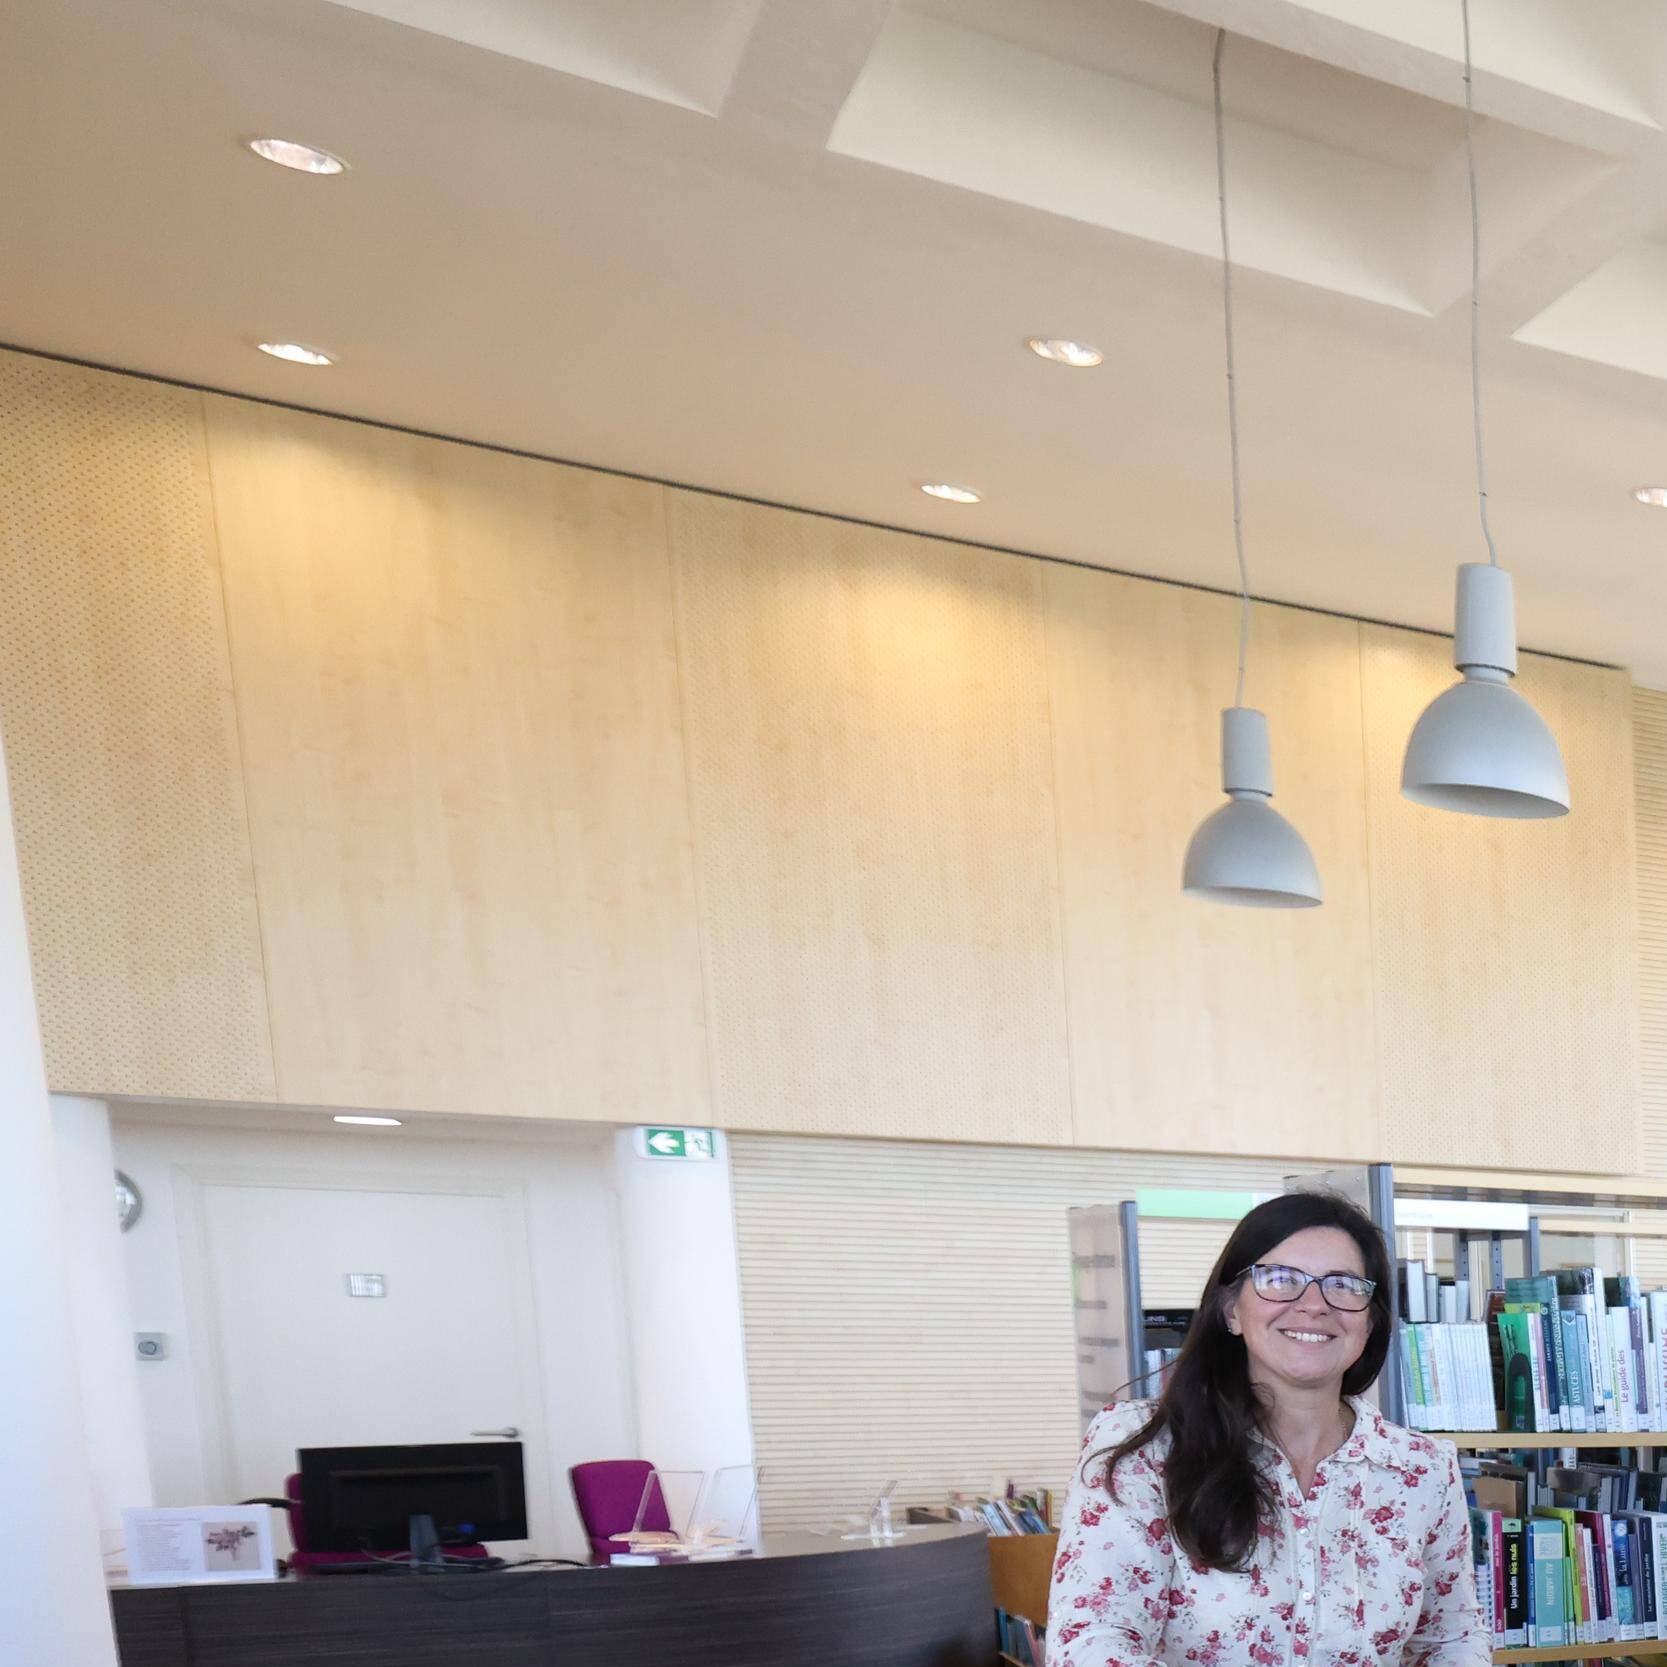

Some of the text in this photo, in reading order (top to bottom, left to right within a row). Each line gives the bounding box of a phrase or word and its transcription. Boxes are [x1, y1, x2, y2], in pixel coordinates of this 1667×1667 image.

[1570, 1370, 1582, 1404] ASTUCES
[1616, 1349, 1630, 1403] Le guide des
[1508, 1543, 1519, 1609] Un jardin les nuls
